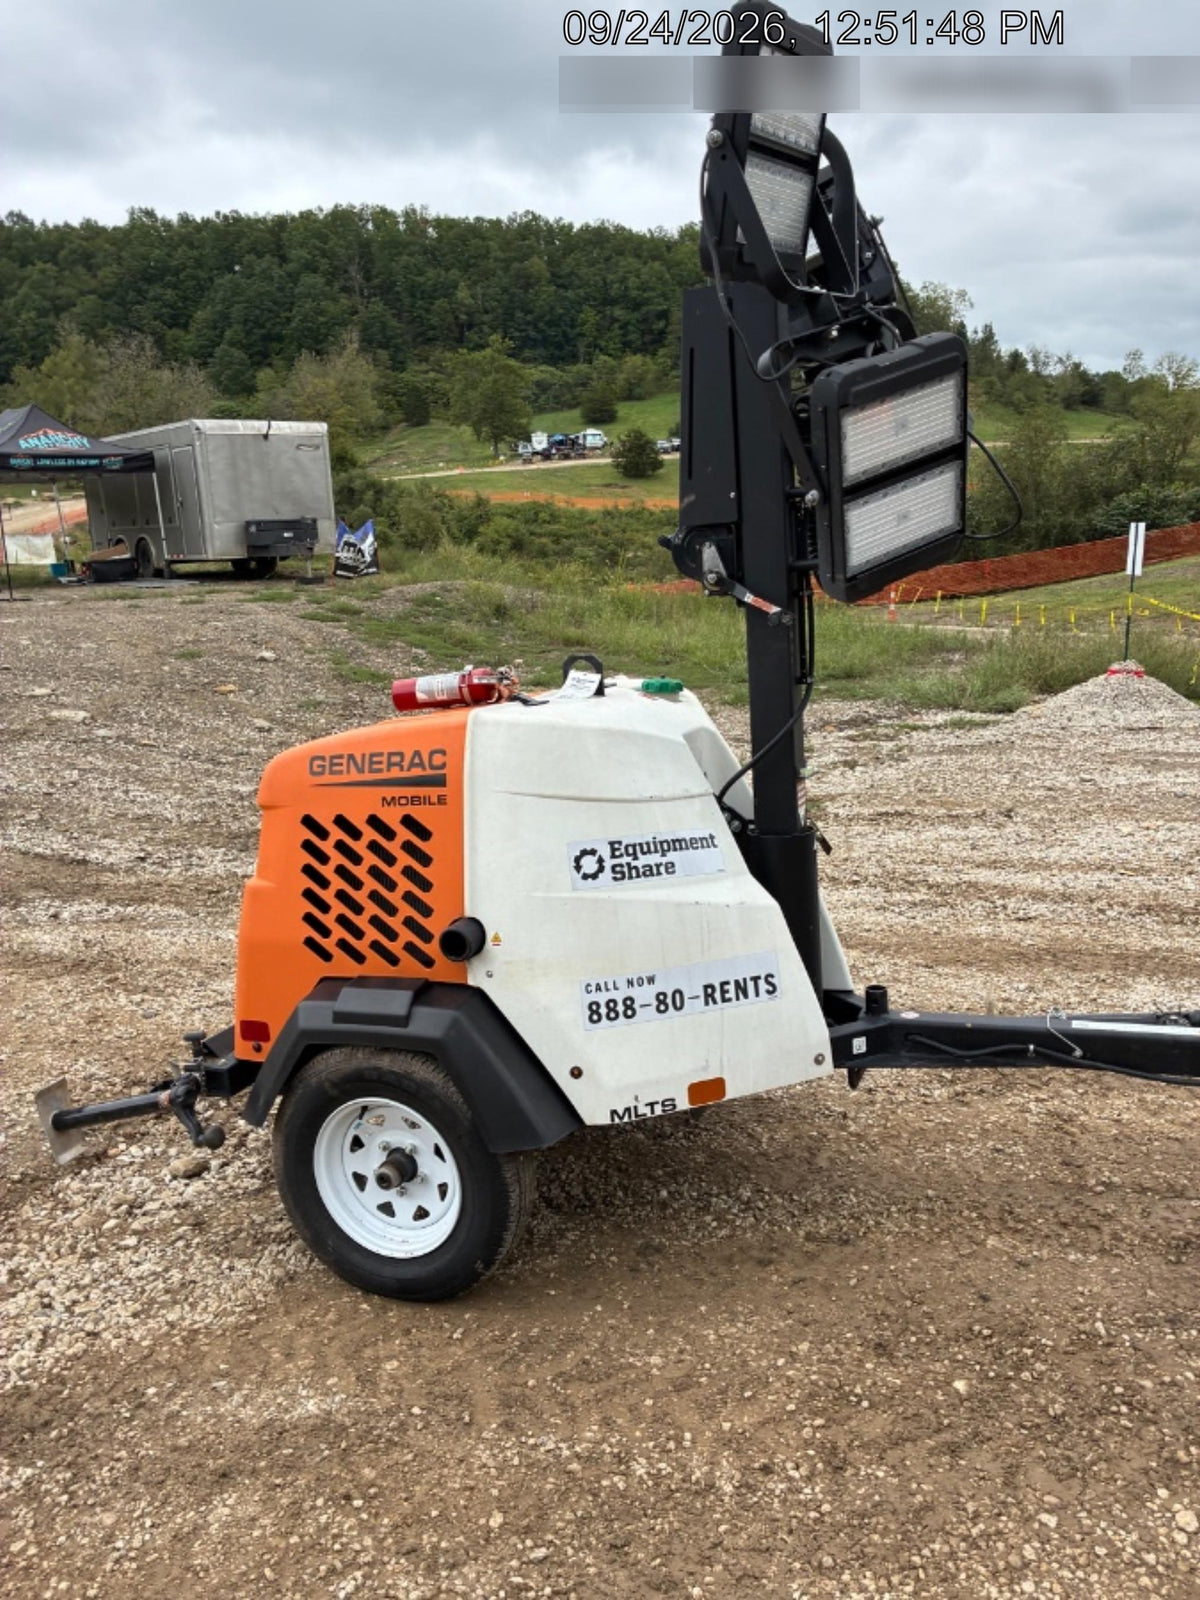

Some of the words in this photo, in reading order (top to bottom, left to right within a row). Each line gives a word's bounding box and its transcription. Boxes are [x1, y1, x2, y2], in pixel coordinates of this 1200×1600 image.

[308, 748, 447, 777] GENERAC
[381, 794, 447, 808] MOBILE
[608, 833, 718, 861] Equipment
[611, 861, 676, 882] Share
[584, 980, 620, 994] CALL
[627, 974, 656, 989] NOW
[587, 973, 778, 1025] 888-80-RENTS
[609, 1097, 677, 1123] MLTS
